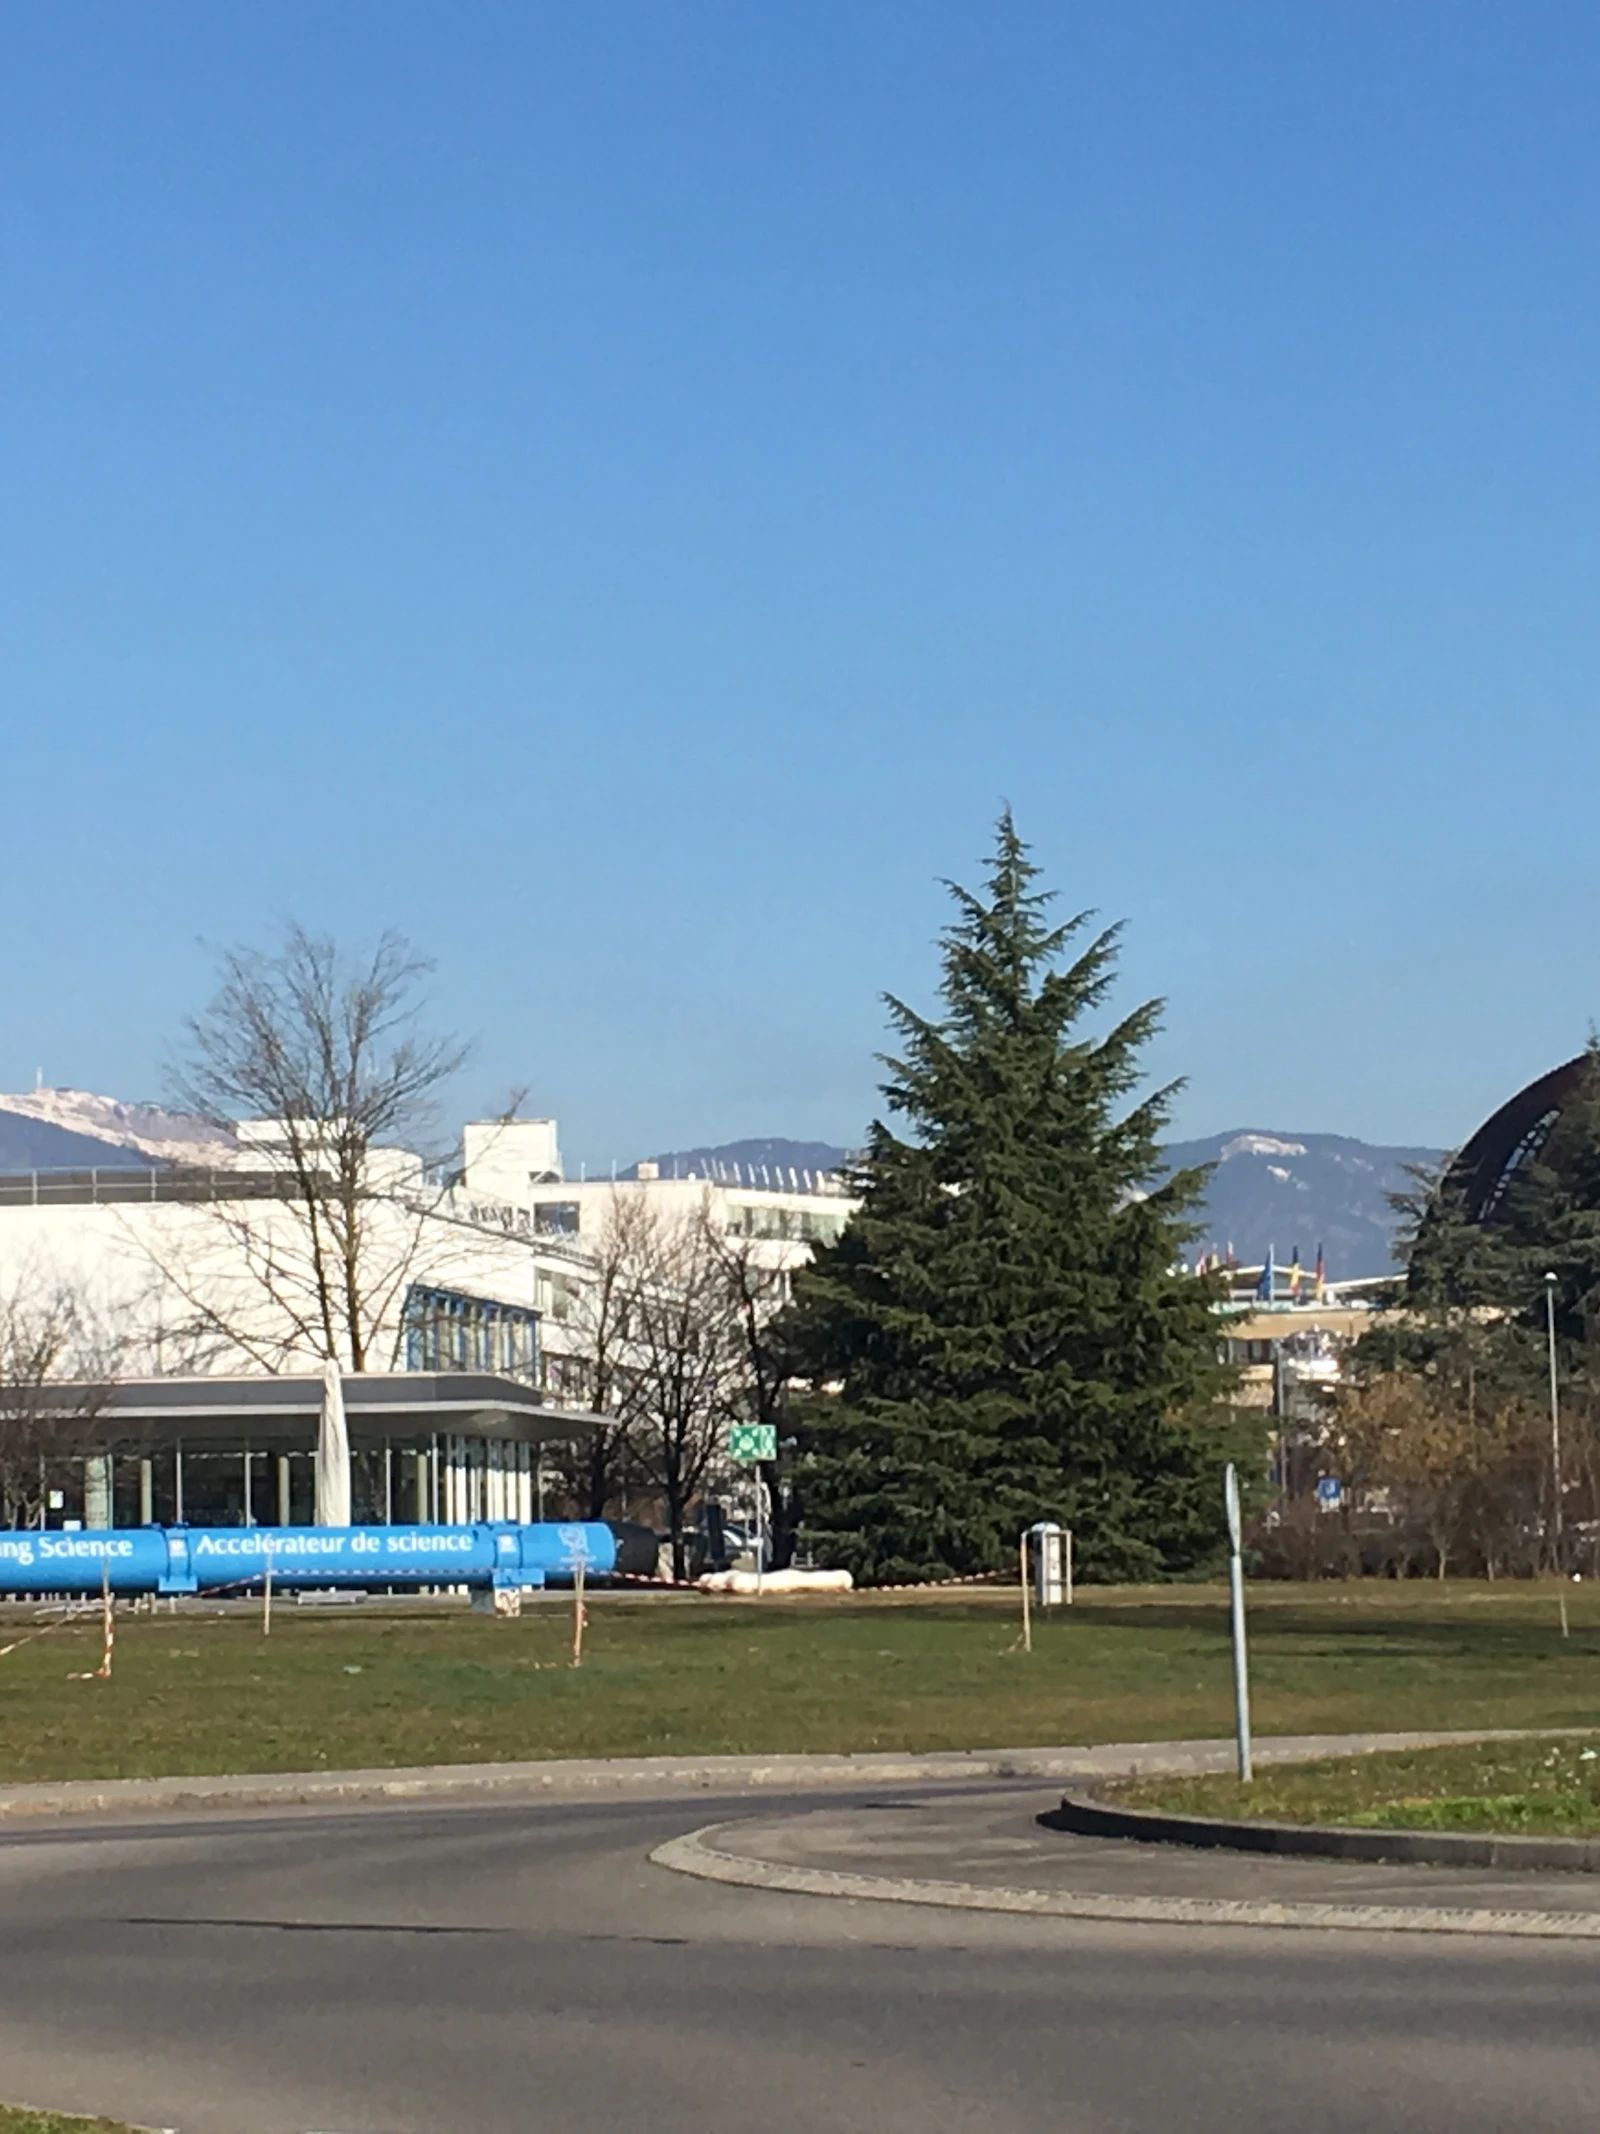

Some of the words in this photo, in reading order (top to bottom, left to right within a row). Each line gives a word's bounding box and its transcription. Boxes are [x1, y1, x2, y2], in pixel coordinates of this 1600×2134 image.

[0, 1541, 34, 1566] ng
[38, 1536, 133, 1558] Science
[351, 1531, 381, 1554] de
[386, 1530, 473, 1553] science
